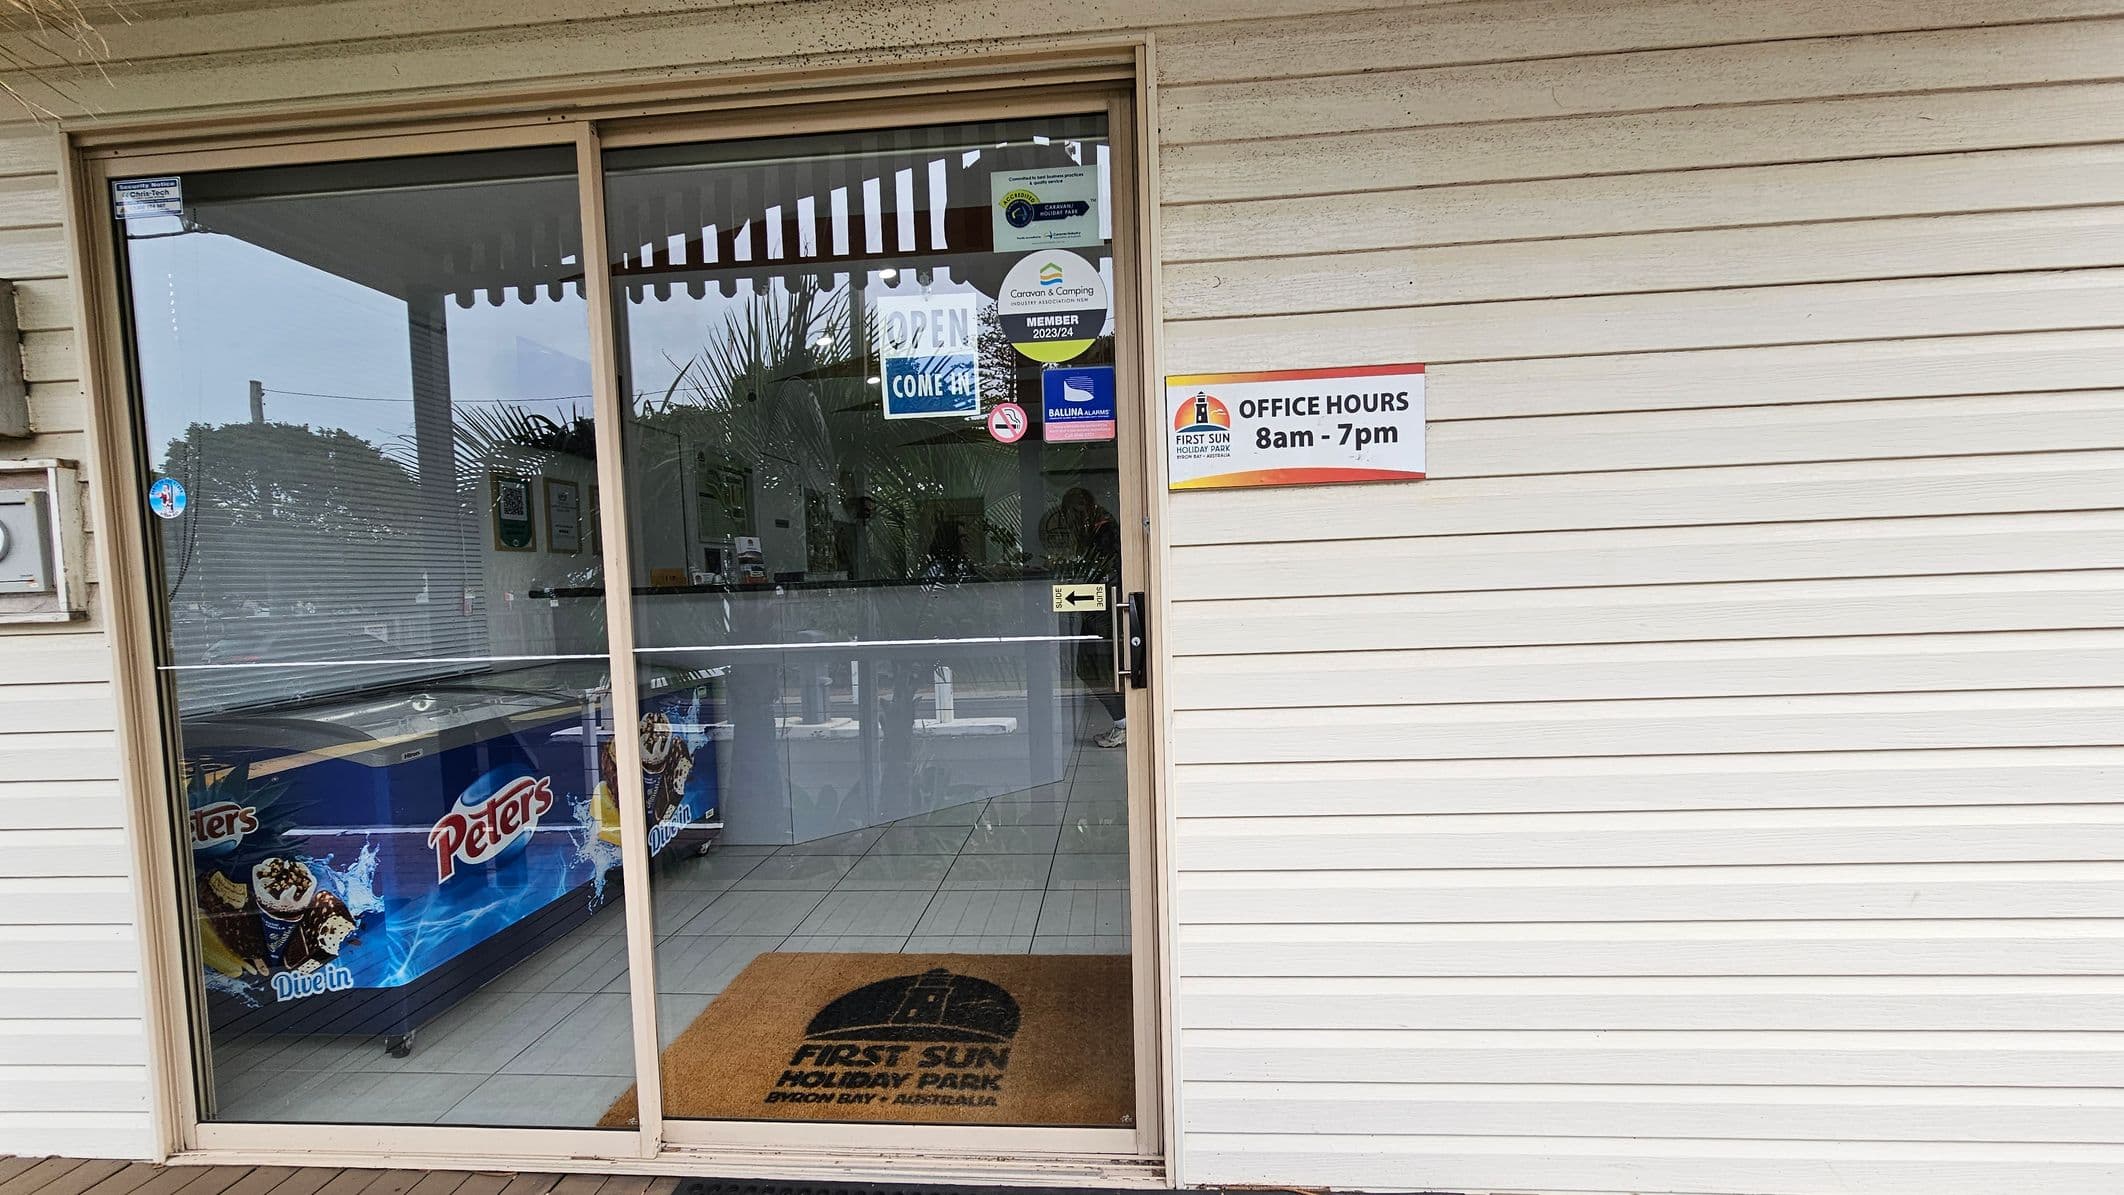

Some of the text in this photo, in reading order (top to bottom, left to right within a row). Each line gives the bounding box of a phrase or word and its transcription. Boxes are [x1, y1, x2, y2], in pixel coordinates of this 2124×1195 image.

[1003, 191, 1036, 206] ACCREDITED
[1010, 286, 1094, 299] Caravan & Camping
[887, 308, 968, 350] OPEN
[1026, 315, 1079, 328] MEMBER
[1033, 327, 1074, 339] 2023/24
[892, 370, 971, 399] COME IN
[1048, 408, 1084, 417] BALLINA
[1239, 391, 1410, 419] OFFICE HOURS
[1176, 432, 1230, 445] FIRST SUN
[1255, 427, 1314, 450] 8am
[1337, 423, 1399, 451] 7pm
[1176, 444, 1231, 454] HOLIDAY PARK
[1096, 586, 1104, 607] SLIDE
[430, 778, 550, 878] Peters
[647, 804, 692, 857] Dive in
[272, 966, 353, 1000] Dive in
[789, 1043, 1012, 1070] FIRST SUN
[775, 1070, 1001, 1091] HOLIDAY PARK
[764, 1091, 998, 1107] BYRON BAY AUSTRALIA
